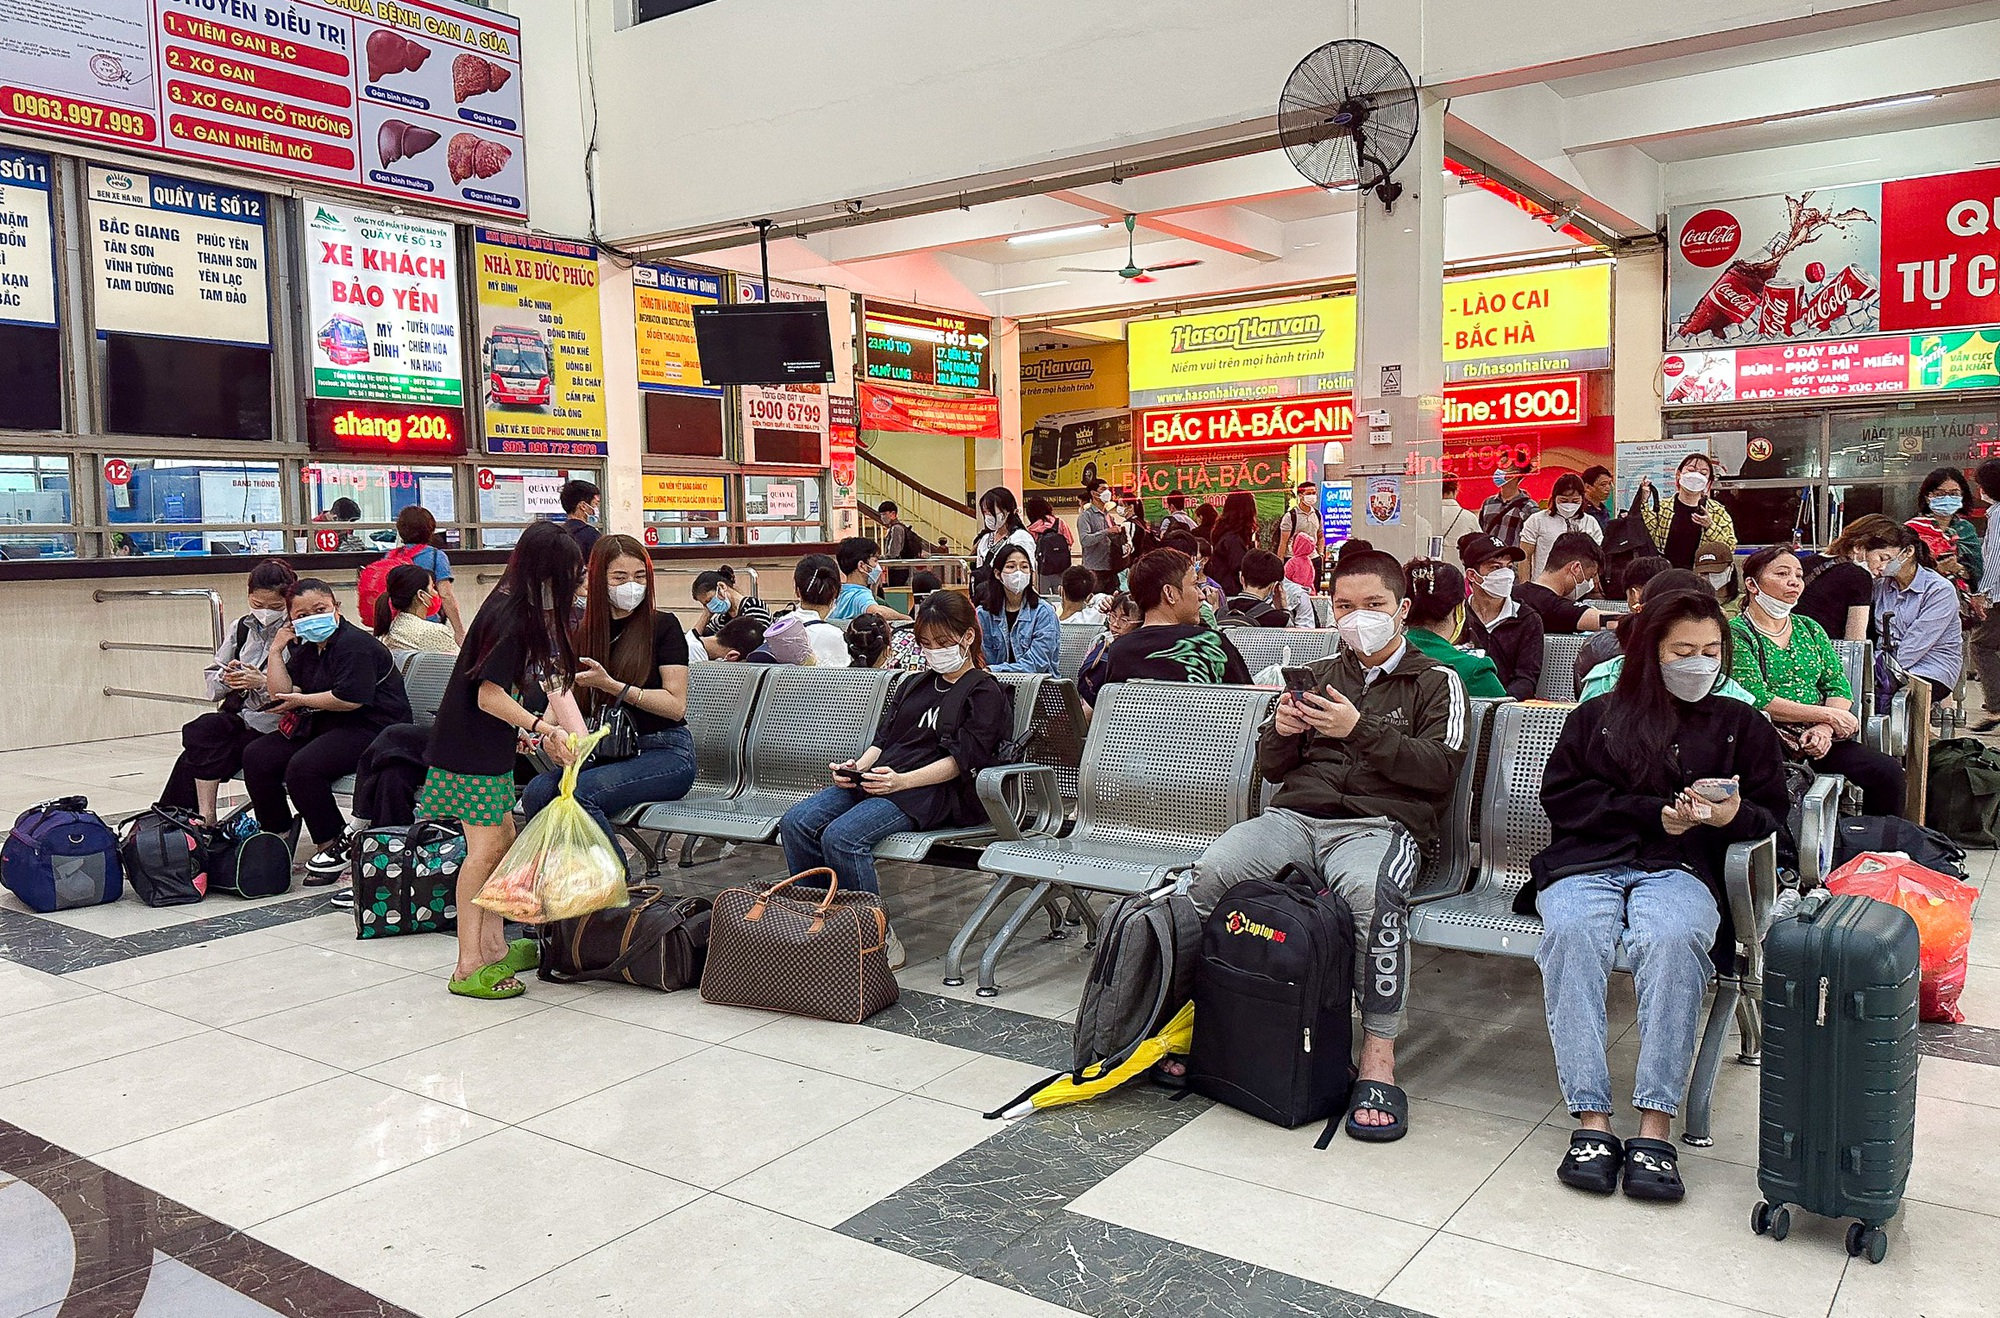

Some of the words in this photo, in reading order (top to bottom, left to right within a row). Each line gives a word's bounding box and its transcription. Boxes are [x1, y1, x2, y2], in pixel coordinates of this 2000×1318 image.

[264, 5, 311, 35] ĐIỀU
[317, 22, 346, 50] TRỊ
[378, 4, 421, 28] BỆNH
[425, 18, 461, 40] GAN
[464, 29, 477, 44] A
[167, 16, 182, 31] 1.
[187, 20, 226, 43] VIÊM
[231, 33, 266, 52] GAN
[270, 43, 297, 60] B,C
[169, 51, 184, 67] 2.
[189, 55, 215, 73] XƠ
[219, 63, 255, 82] GAN
[371, 88, 386, 98] Gan
[171, 87, 187, 101] 3.
[192, 90, 217, 107] XƠ
[221, 98, 257, 116] GAN
[261, 102, 286, 122] CỔ
[12, 92, 144, 136] 0963.997.993
[473, 113, 487, 121] Gan
[173, 122, 189, 137] 4.
[193, 126, 230, 145] GAN
[235, 133, 283, 155] NHIỄM
[376, 172, 390, 183] Gan
[153, 186, 194, 209] QUẦY
[198, 193, 217, 211] VÉ
[470, 191, 484, 200] Gan
[99, 217, 130, 235] BẮC
[135, 224, 180, 242] GIANG
[1682, 224, 1738, 247] Coca-Cola
[103, 240, 127, 254] TÂN
[130, 243, 154, 257] SƠN
[196, 233, 226, 248] PHÚC
[229, 236, 249, 251] YÊN
[394, 232, 408, 243] VÉ
[430, 239, 442, 249] 13
[198, 252, 233, 267] THANH
[236, 254, 257, 270] SƠN
[320, 239, 353, 267] XE
[363, 248, 445, 280] KHÁCH
[136, 262, 174, 278] TƯỜNG
[199, 269, 220, 283] YÊN
[484, 252, 512, 276] NHÀ
[515, 259, 532, 279] XE
[534, 259, 560, 282] ĐỨC
[563, 264, 594, 287] PHÚC
[2, 273, 29, 289] KẠN
[106, 277, 132, 290] TAM
[135, 280, 174, 296] DƯƠNG
[660, 271, 675, 287] BẾN
[677, 275, 686, 289] XE
[1897, 253, 1957, 310] TỰ
[200, 288, 222, 302] TAM
[332, 276, 384, 308] BẢO
[392, 283, 438, 314] YẾN
[1463, 292, 1506, 316] LÀO
[1512, 289, 1549, 310] CAI
[1716, 283, 1756, 312] Coca-Cola
[534, 301, 551, 310] NINH
[539, 314, 552, 324] SAO
[377, 320, 393, 338] MỸ
[431, 323, 454, 337] QUANG
[1456, 323, 1498, 350] BẮC
[1504, 320, 1535, 345] HÀ
[374, 342, 399, 359] ĐÌNH
[1200, 360, 1217, 371] vui
[1219, 356, 1239, 368] trên
[1265, 351, 1293, 364] hành
[1297, 348, 1325, 362] trình
[410, 360, 421, 371] NA
[423, 360, 442, 373] HANG
[1463, 357, 1569, 378] fb/hasonhaivan
[1740, 363, 1773, 377] BÚN
[1831, 356, 1851, 370] MÌ
[1792, 374, 1814, 386] SỐT
[1816, 374, 1849, 384] VANG
[1157, 383, 1278, 404] www.hasonhaivan.com
[1741, 388, 1757, 399] GÀ
[1784, 386, 1809, 397] MỌC
[1819, 383, 1839, 394] GIÒ
[1849, 381, 1872, 393] XÚC
[1875, 380, 1903, 391] XÍCH
[749, 400, 783, 420] 1900
[788, 403, 820, 423] 6799
[334, 411, 401, 442] ahang
[407, 415, 452, 440] 200.
[521, 426, 530, 434] XE
[566, 427, 589, 437] ONLINE
[528, 442, 548, 453] 096
[550, 443, 569, 454] 772
[108, 465, 128, 479] 12
[480, 472, 493, 485] 14
[321, 533, 336, 548] 13
[646, 531, 658, 542] 15
[750, 529, 759, 541] 16
